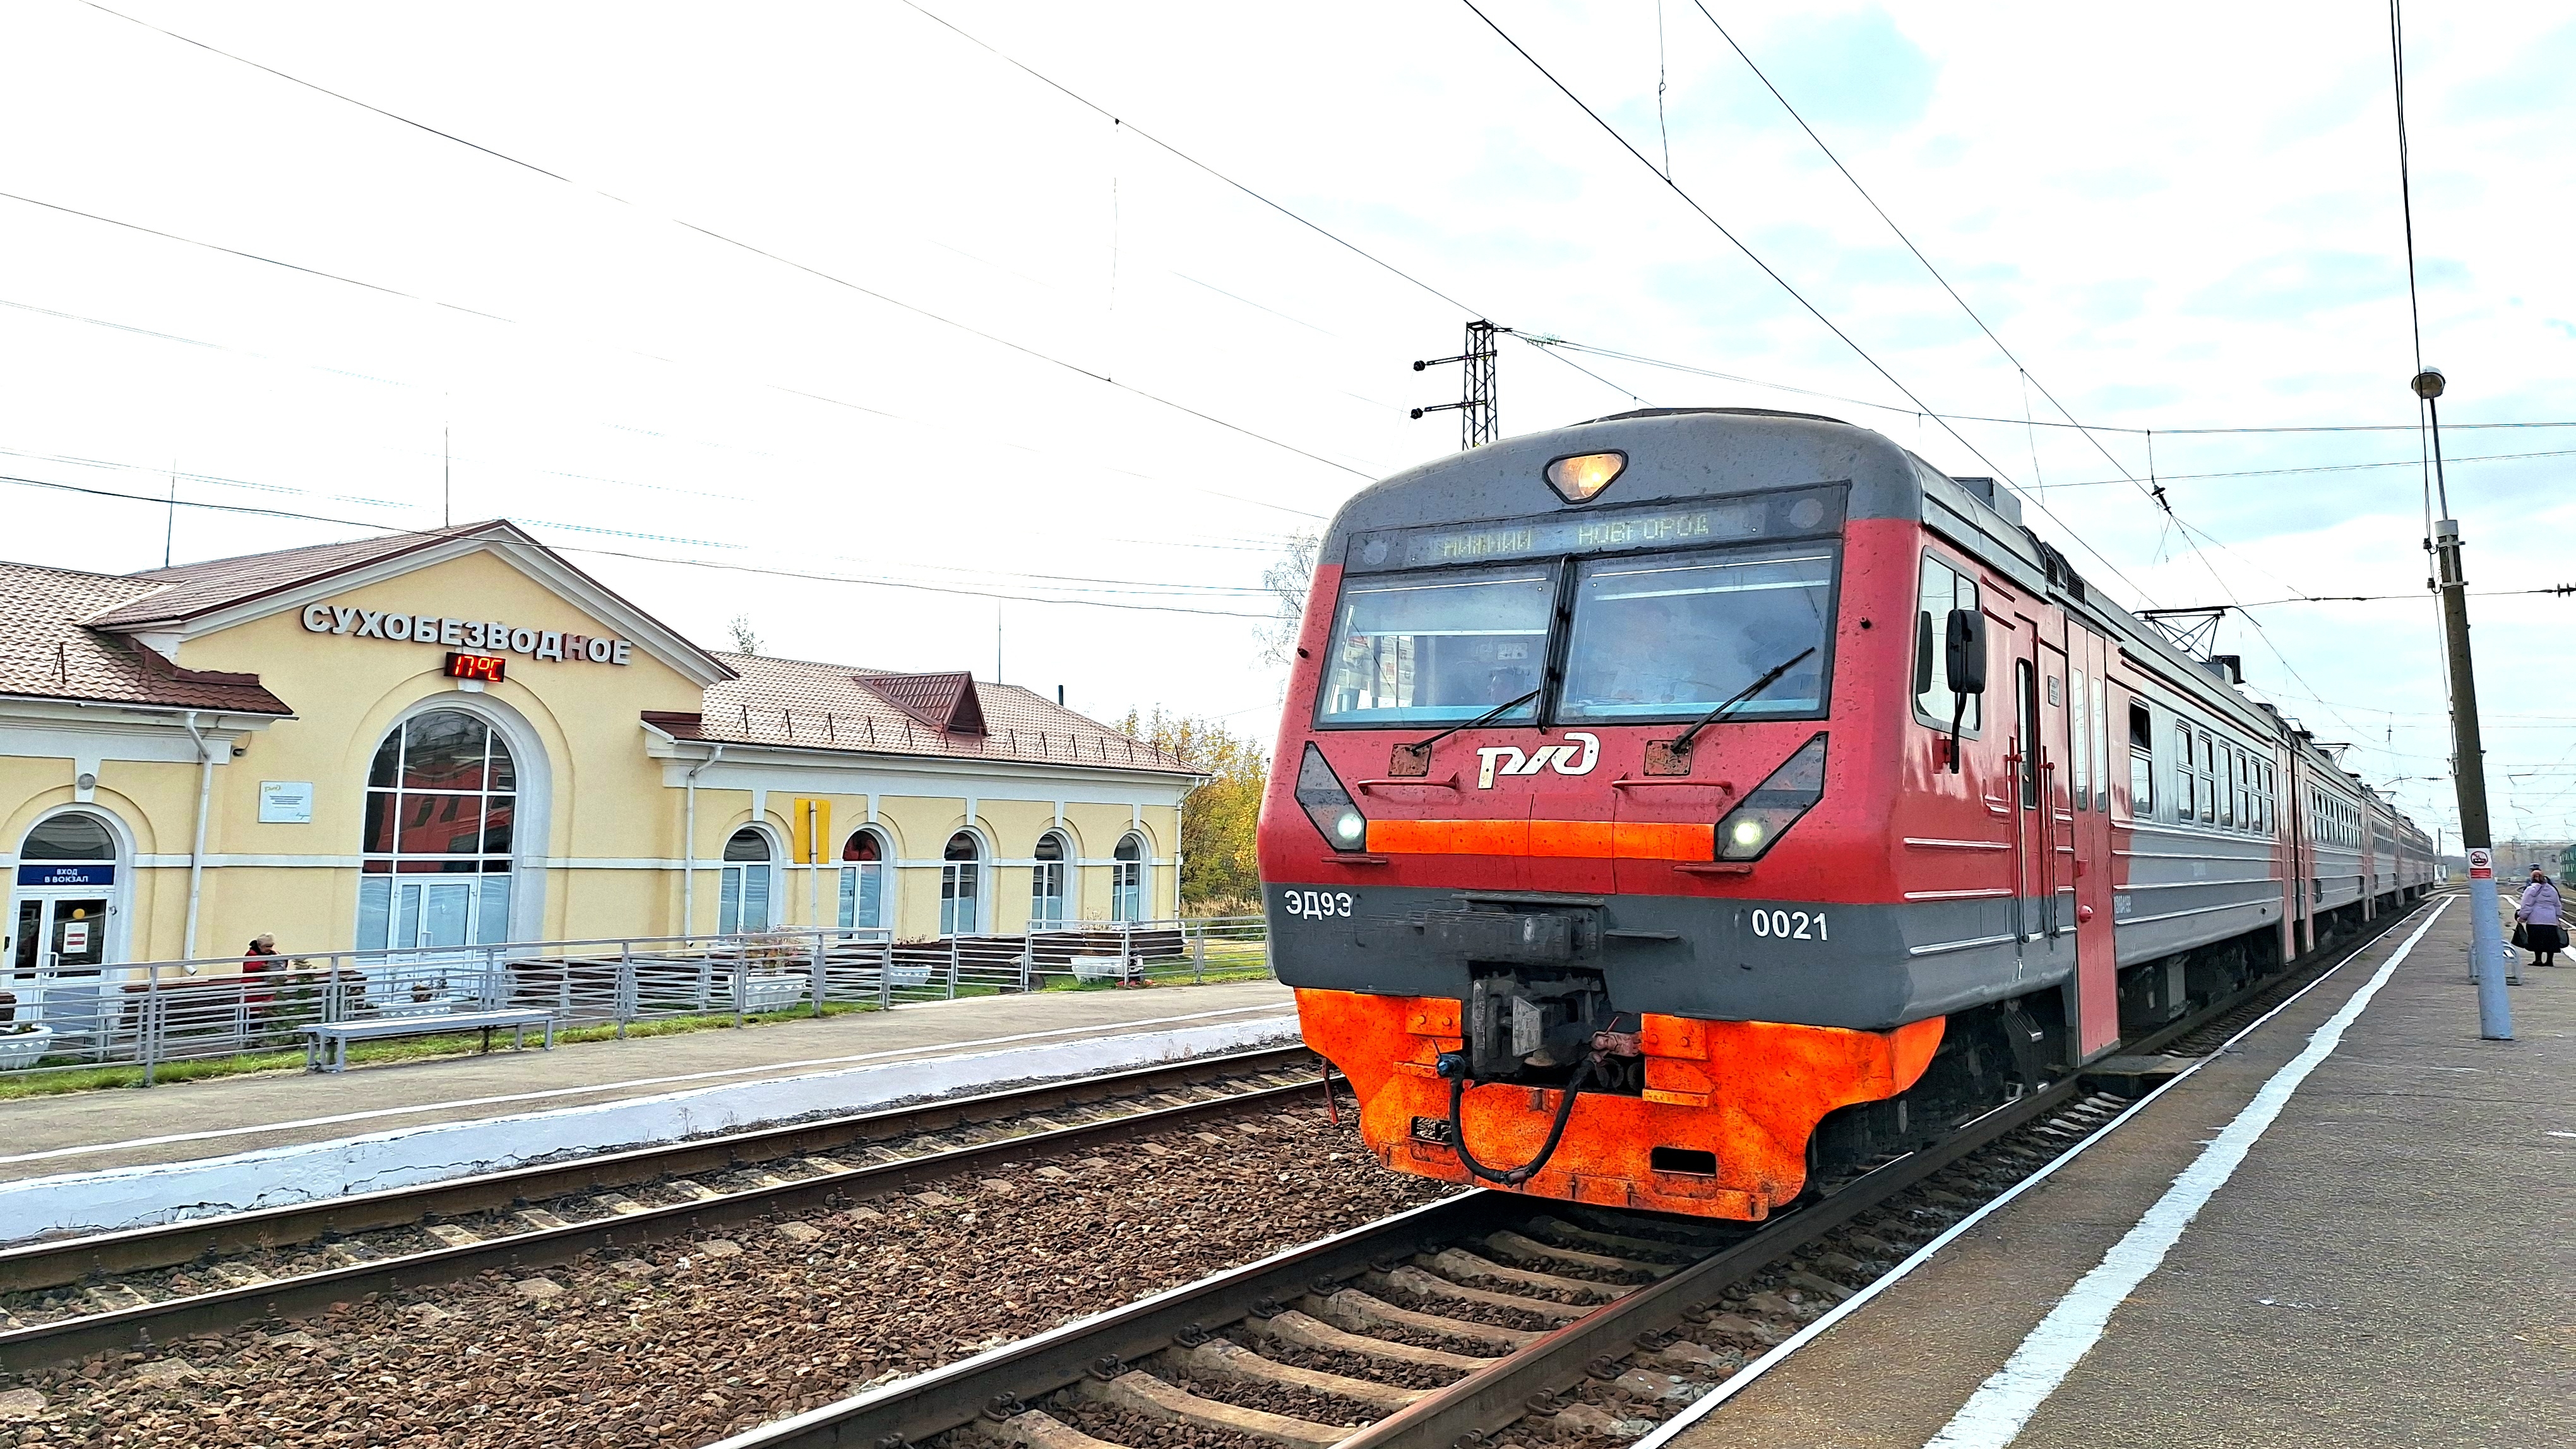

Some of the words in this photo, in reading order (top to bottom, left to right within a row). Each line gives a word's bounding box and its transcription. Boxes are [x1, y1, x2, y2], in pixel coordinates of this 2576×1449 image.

[1578, 514, 1708, 546] НОВГОРОД
[302, 604, 631, 665] СУХОБЕЗВОДНОЕ
[1284, 890, 1353, 921] ЭД9Э
[1751, 909, 1828, 941] 0021
